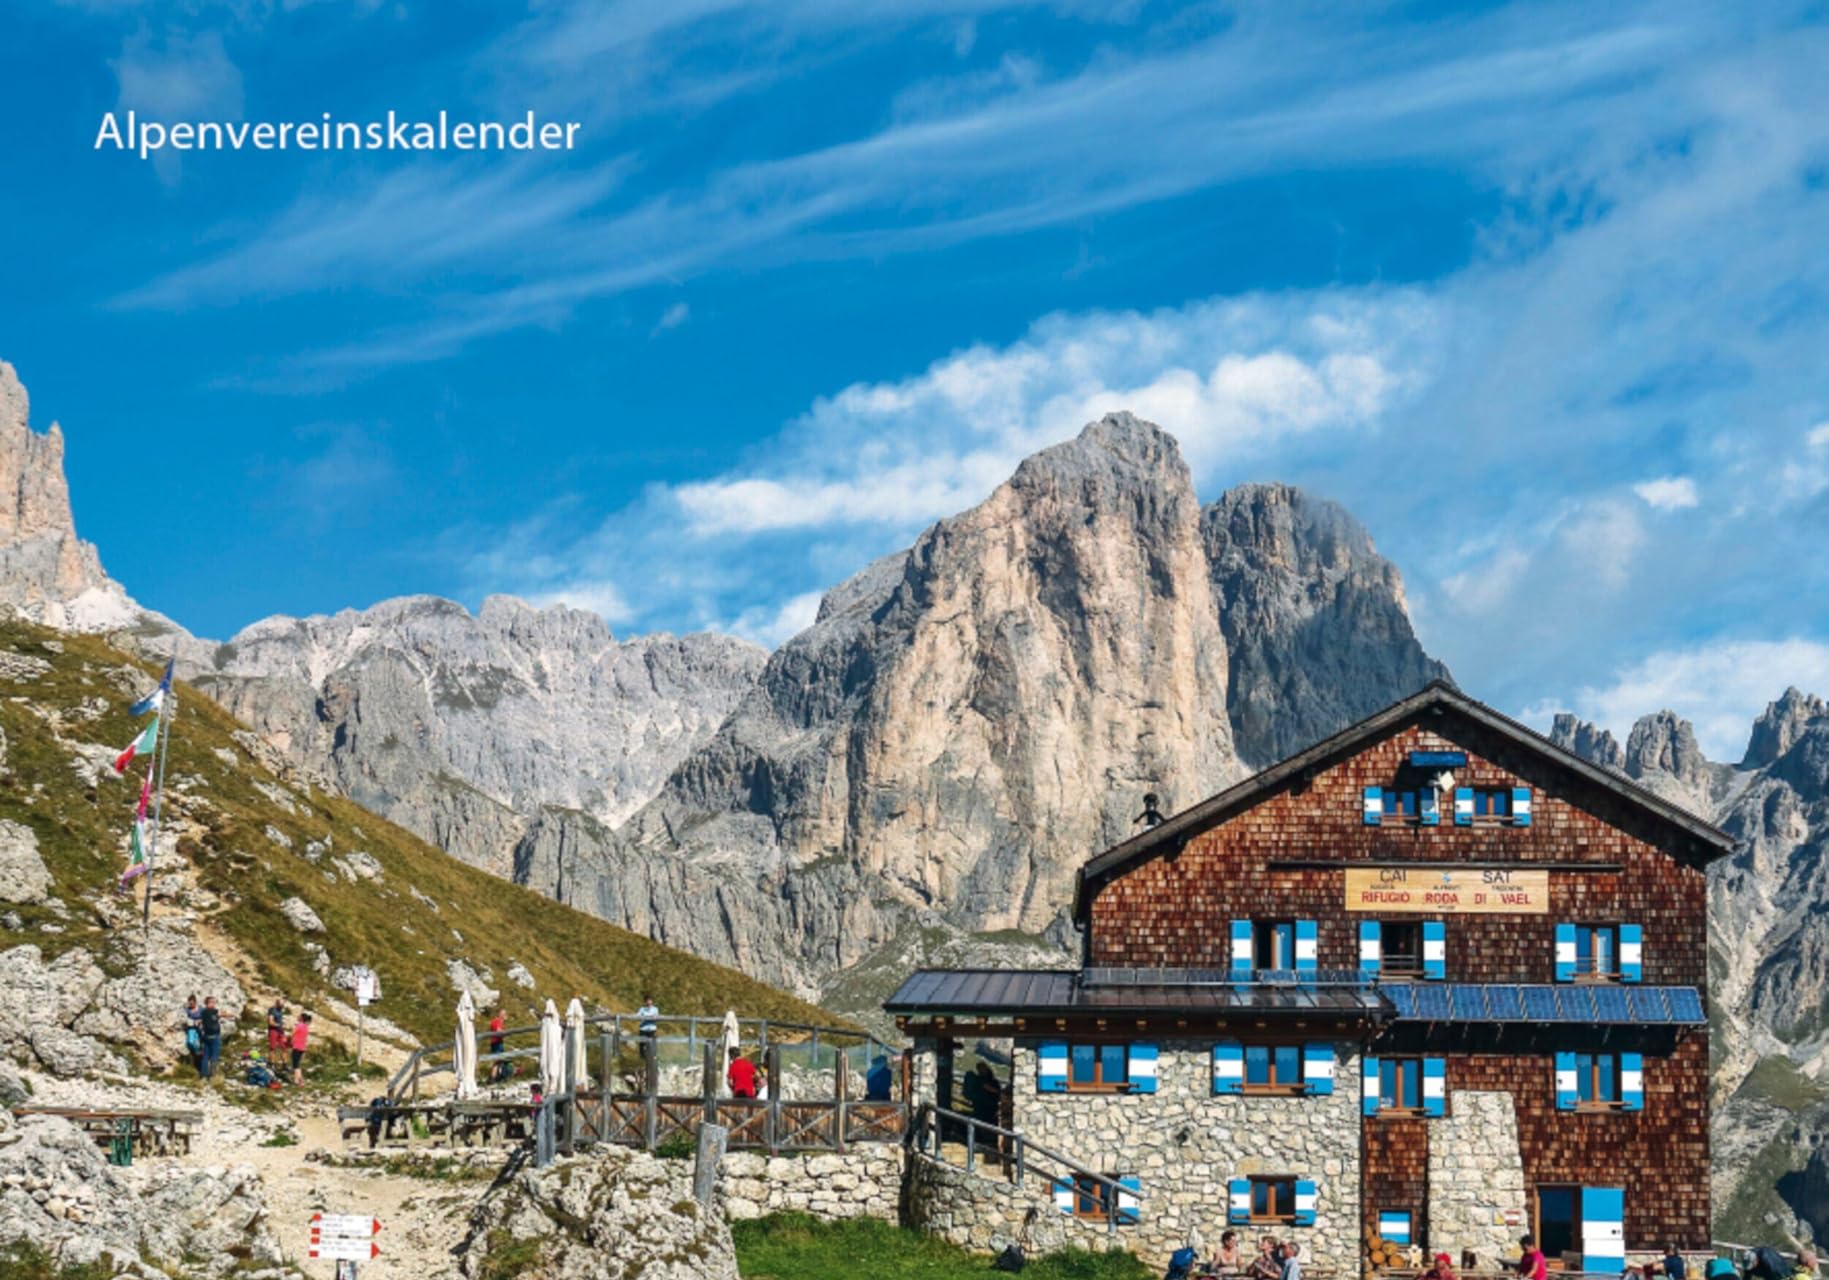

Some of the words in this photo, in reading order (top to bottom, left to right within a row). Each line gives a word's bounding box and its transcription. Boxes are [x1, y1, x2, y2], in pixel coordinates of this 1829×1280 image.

[1380, 869, 1407, 883] CAI
[1482, 870, 1513, 884] SAT
[1361, 891, 1410, 904] RIFUGIO
[1425, 892, 1459, 904] RODA
[1475, 892, 1487, 905] DI
[1500, 893, 1532, 905] VAEL
